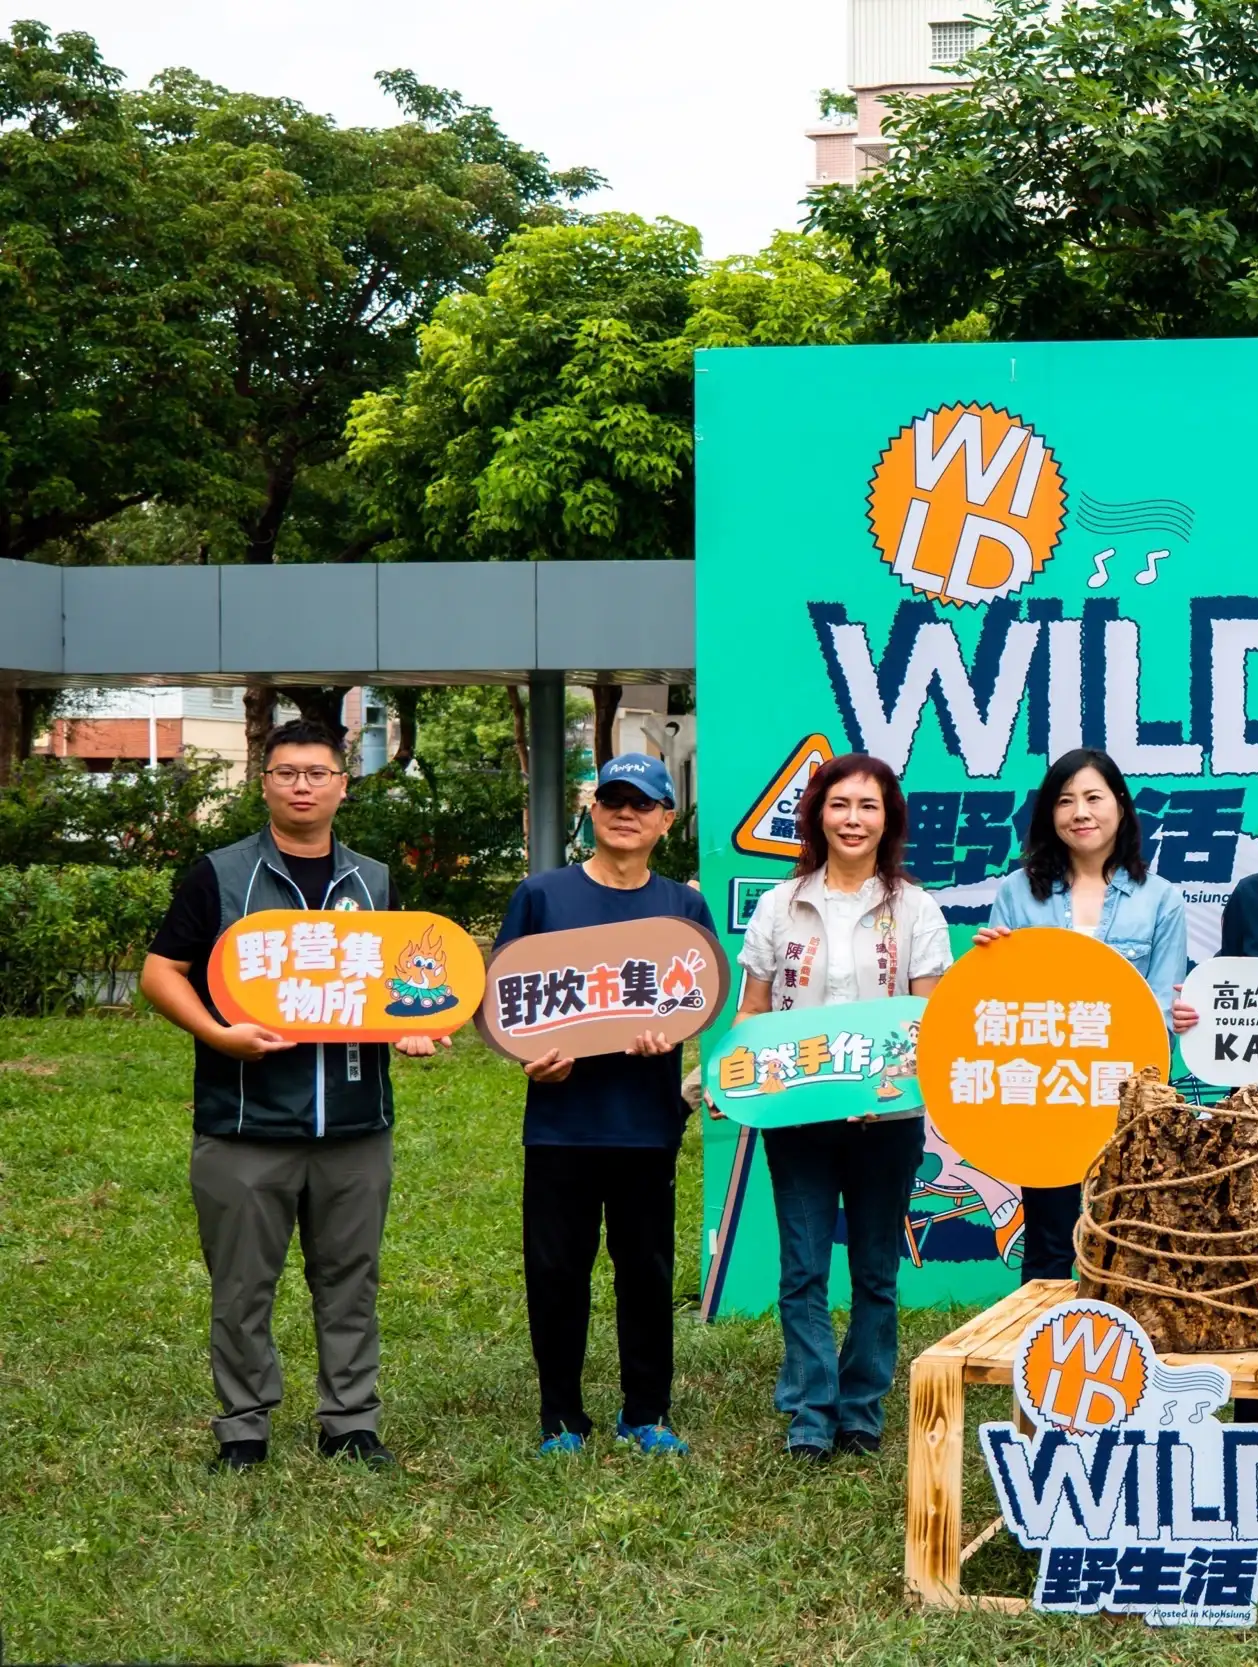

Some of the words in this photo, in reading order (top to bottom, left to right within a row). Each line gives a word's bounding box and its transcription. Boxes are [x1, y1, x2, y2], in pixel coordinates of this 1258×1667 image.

[902, 788, 1246, 890] 野活
[1183, 890, 1231, 906] hsiung
[236, 922, 384, 982] 野營集
[278, 977, 367, 1026] 物所
[497, 959, 658, 1029] 野炊市集
[974, 1000, 1111, 1048] 衛武營
[720, 1031, 875, 1090] 自然手作
[950, 1057, 1134, 1106] 都會公園
[1042, 1547, 1258, 1607] 野生活
[1202, 1609, 1251, 1620] Kaohsiung
